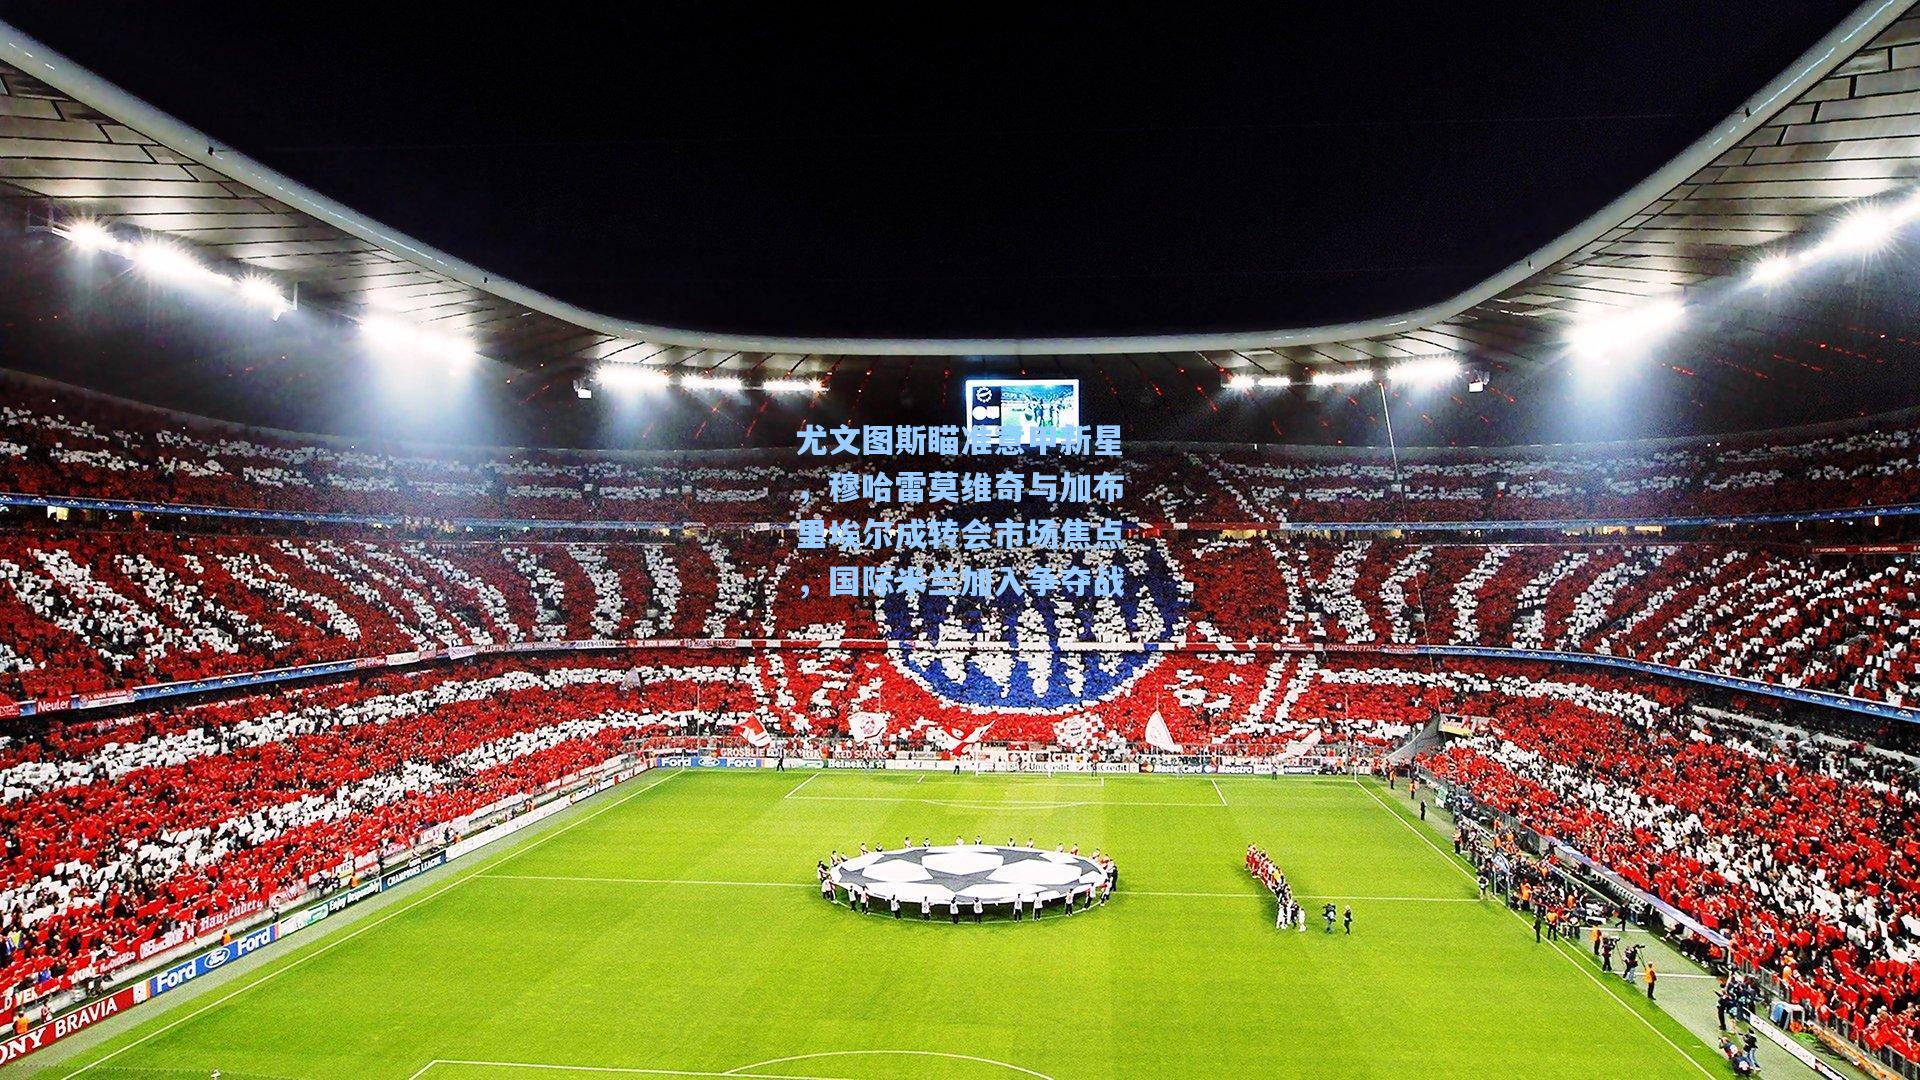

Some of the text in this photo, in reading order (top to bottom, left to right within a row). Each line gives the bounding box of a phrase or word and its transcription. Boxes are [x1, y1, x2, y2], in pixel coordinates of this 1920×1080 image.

[237, 927, 271, 956] Ford
[156, 959, 196, 993] Ford
[55, 997, 118, 1039] BRAVIA
